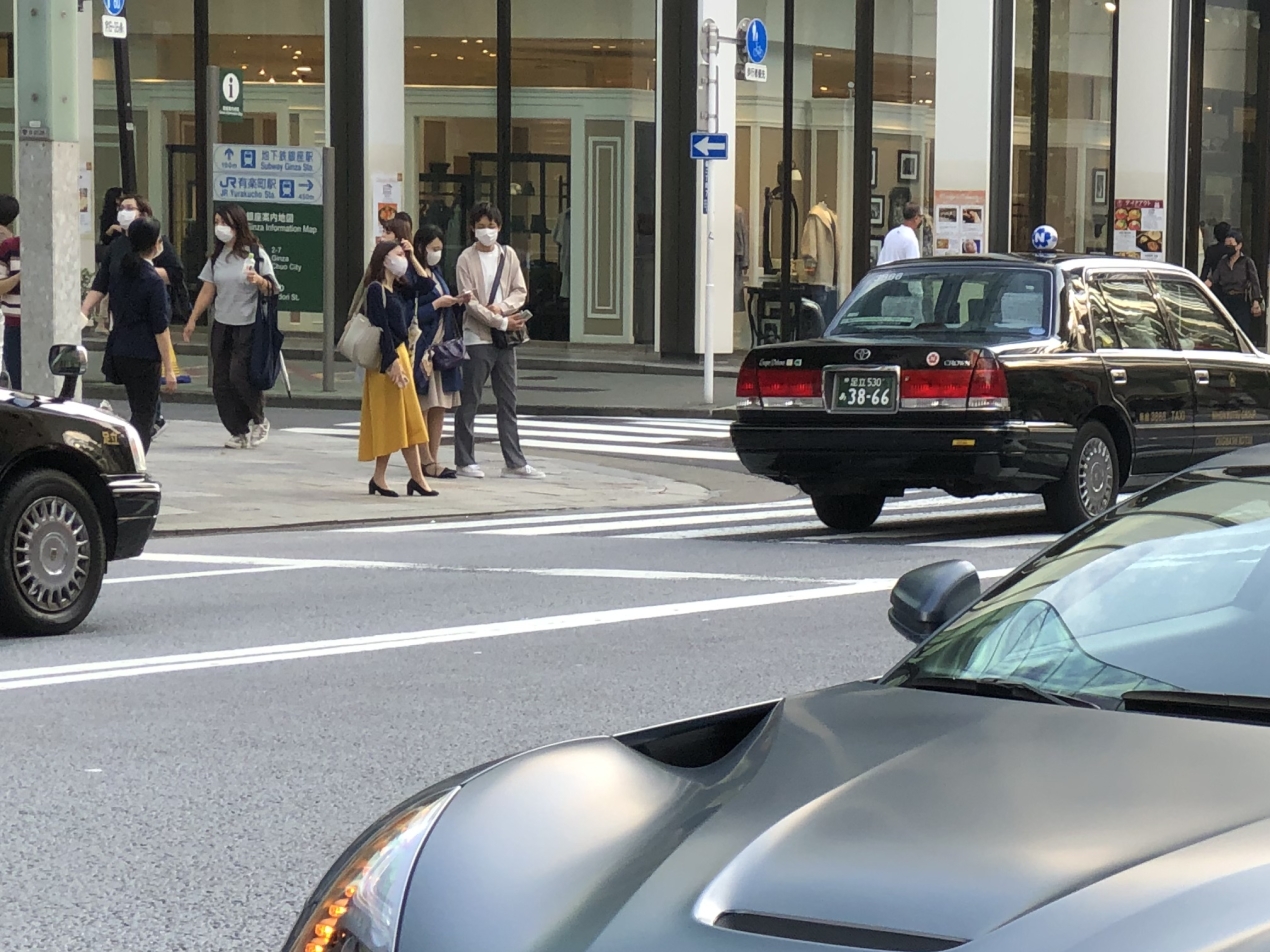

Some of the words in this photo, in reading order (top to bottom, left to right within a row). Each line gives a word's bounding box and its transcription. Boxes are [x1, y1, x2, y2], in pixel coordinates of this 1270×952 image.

[260, 162, 283, 171] Subway
[284, 163, 302, 171] Ginza
[220, 176, 237, 188] JR
[230, 190, 262, 199] Yurakucho
[265, 223, 302, 233] Information
[302, 224, 318, 235] Map
[289, 264, 302, 273] City
[867, 378, 882, 387] 530
[847, 388, 890, 405] 38-66
[1171, 410, 1186, 421] TAXI
[101, 431, 120, 446] 足立
